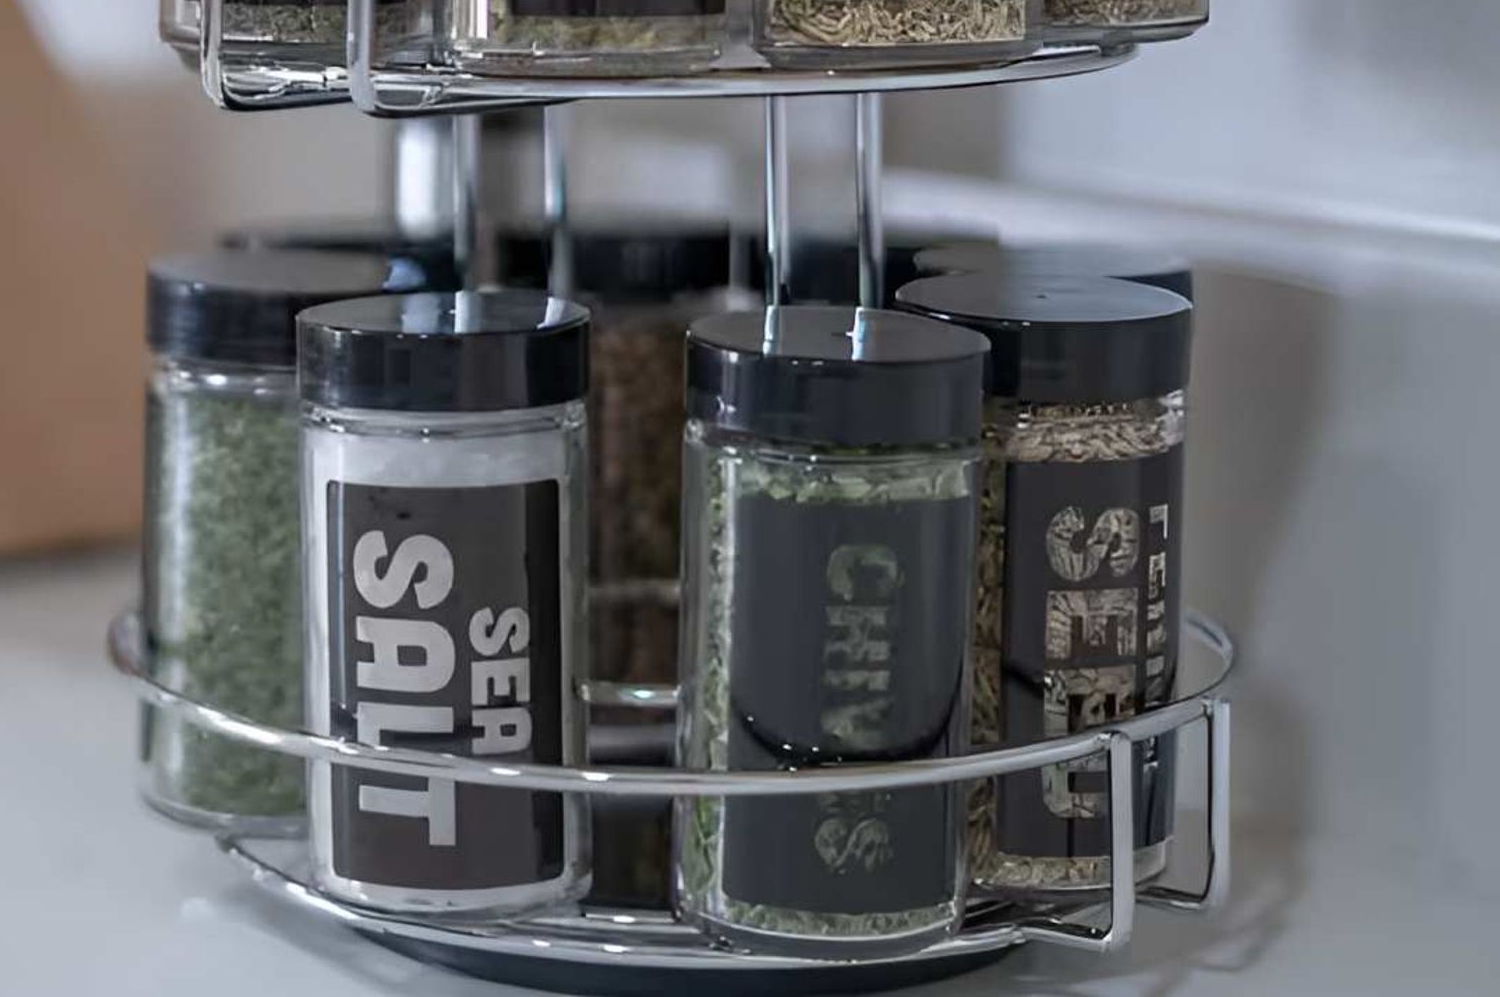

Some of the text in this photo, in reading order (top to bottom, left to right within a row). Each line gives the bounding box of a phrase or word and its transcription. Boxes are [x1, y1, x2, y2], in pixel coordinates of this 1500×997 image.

[353, 530, 455, 845] SALT
[469, 606, 532, 756] SEA
[1043, 506, 1139, 818] SEED
